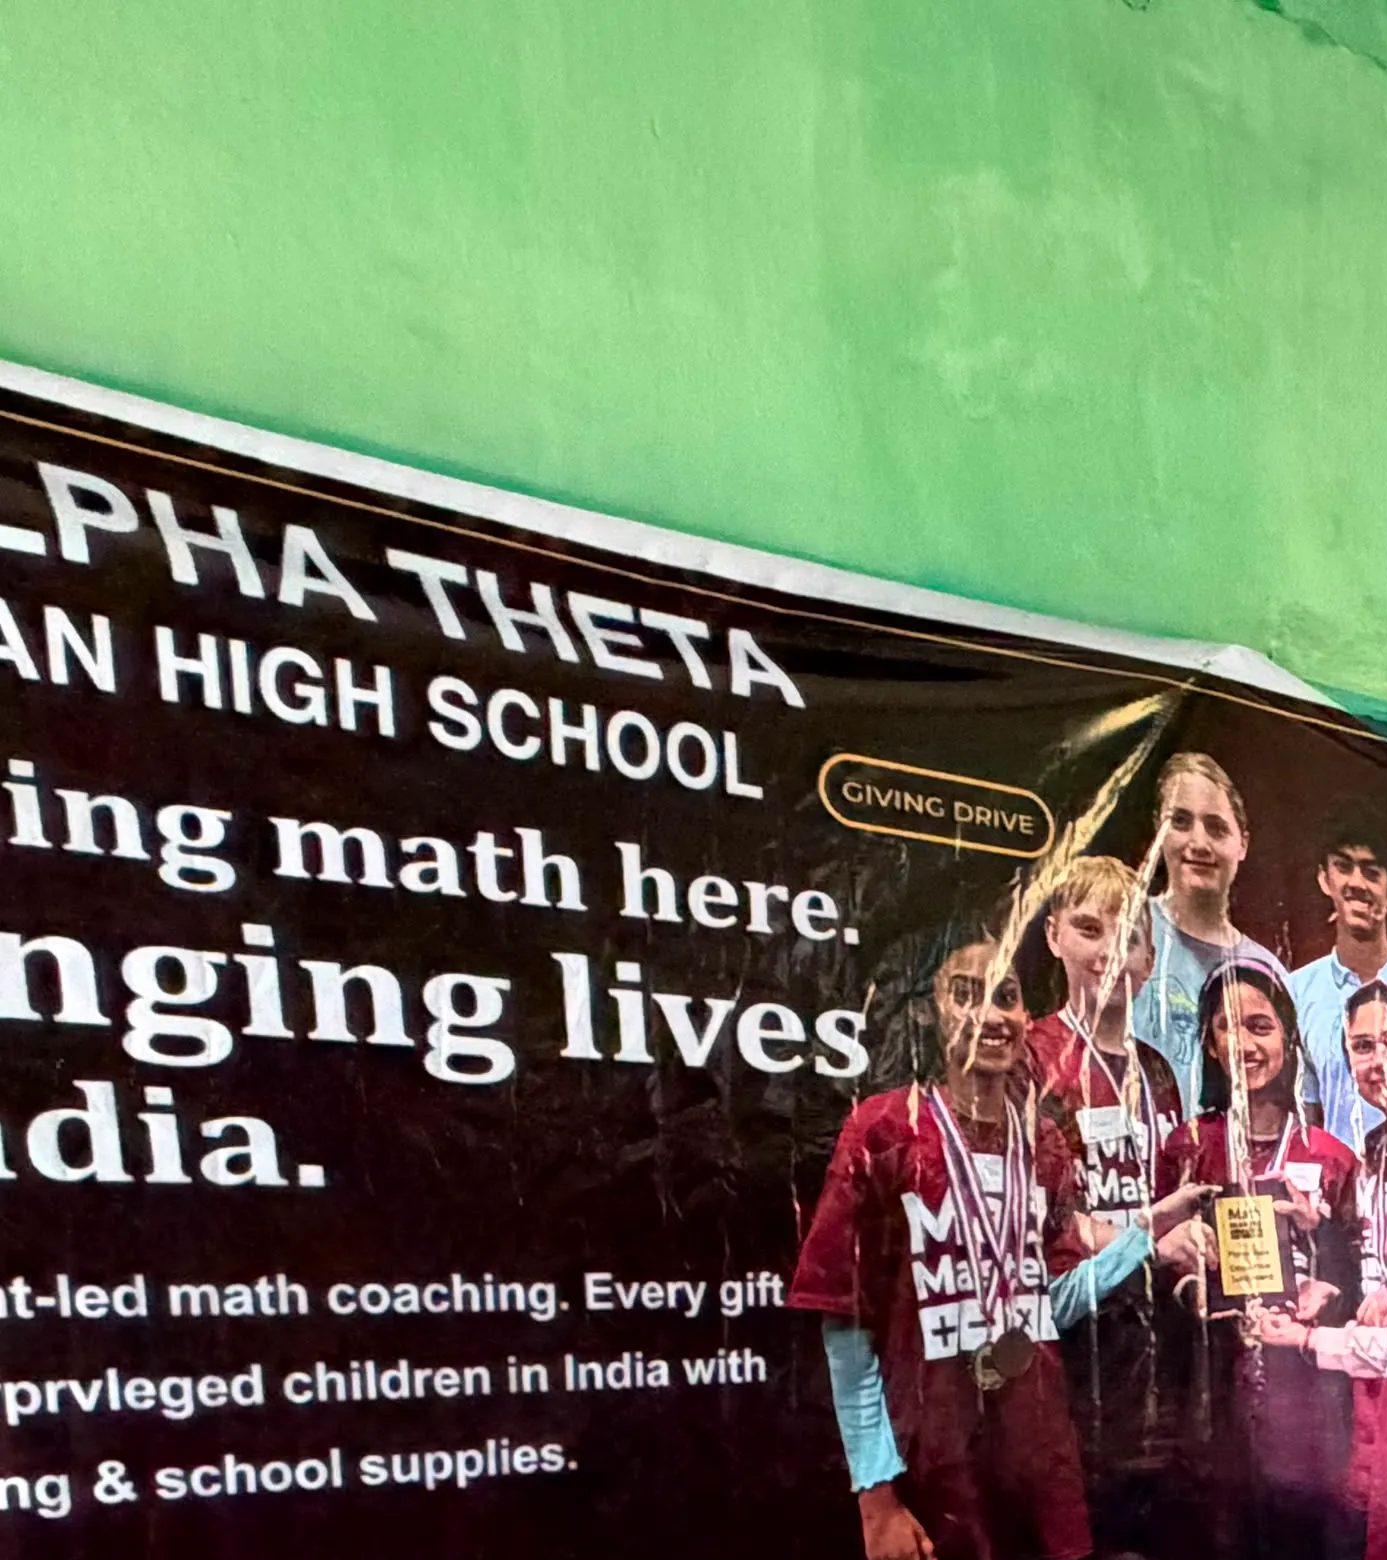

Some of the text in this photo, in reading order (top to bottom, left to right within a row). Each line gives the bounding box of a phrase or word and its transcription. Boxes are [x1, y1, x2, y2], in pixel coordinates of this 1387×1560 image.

[386, 548, 805, 708] THETA
[155, 626, 395, 737] HIGH
[428, 676, 763, 799] SCHOOL
[2, 759, 859, 944] ing math here.
[842, 781, 1034, 836] GIVING DRIVE
[0, 924, 875, 1083] nging lives
[0, 1080, 327, 1187] dia.
[168, 1273, 309, 1317] math
[327, 1273, 569, 1322] coaching.
[585, 1272, 706, 1317] Every
[719, 1270, 785, 1317] gift
[283, 1359, 491, 1404] children
[508, 1355, 549, 1393] in
[565, 1351, 670, 1391] India
[683, 1347, 767, 1385] with
[0, 1437, 578, 1519] ng & school supplies.
